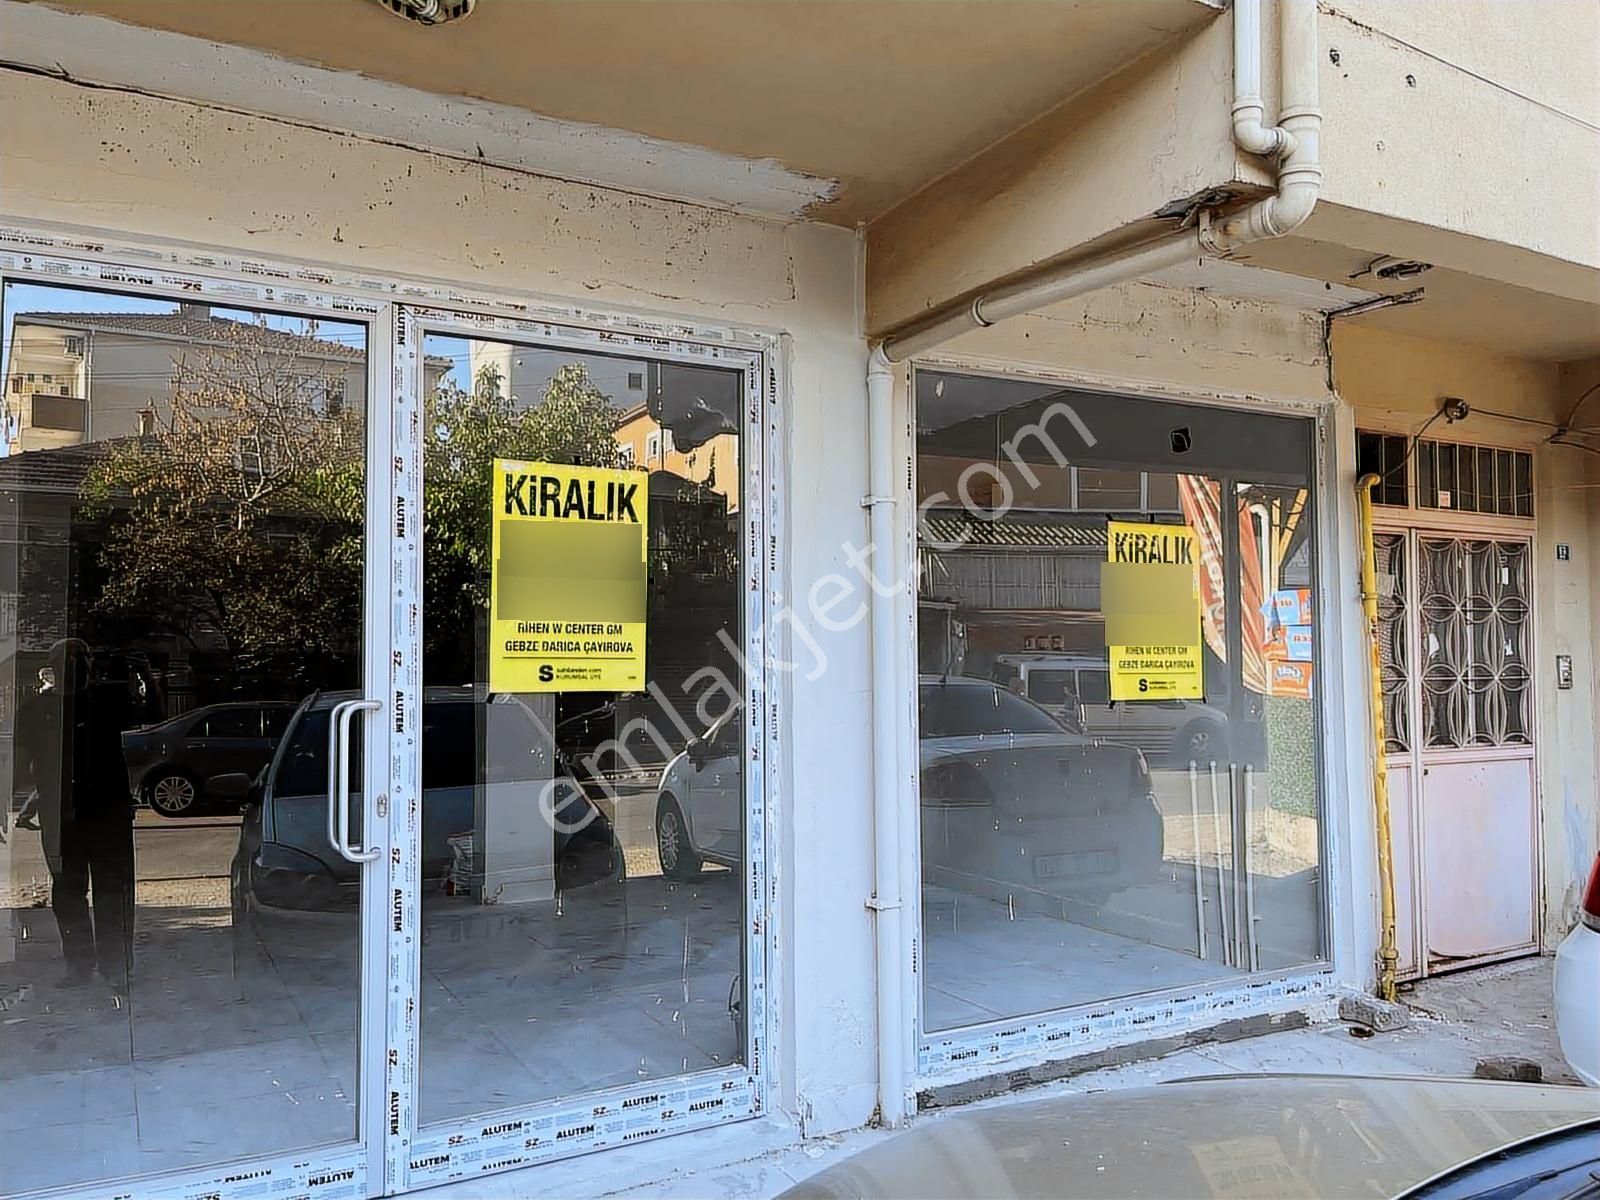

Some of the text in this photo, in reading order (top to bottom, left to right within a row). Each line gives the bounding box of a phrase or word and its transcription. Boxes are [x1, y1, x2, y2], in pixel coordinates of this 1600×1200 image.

[396, 495, 406, 539] ALUTEM
[505, 640, 633, 654] GEBZE DARICA ÇAYIROVA
[553, 623, 563, 634] W
[565, 624, 604, 635] CENTER
[607, 625, 623, 635] GM
[395, 690, 404, 733] ALUTEM
[393, 888, 403, 932] ALUTEM
[390, 1091, 400, 1136] ALUTEM
[481, 1121, 522, 1137] ALUTEM
[622, 1094, 659, 1109] ALUTEM
[556, 1124, 595, 1140] ALUTEM
[688, 1098, 724, 1112] ALUTEM
[308, 1170, 355, 1187] ALUTEM
